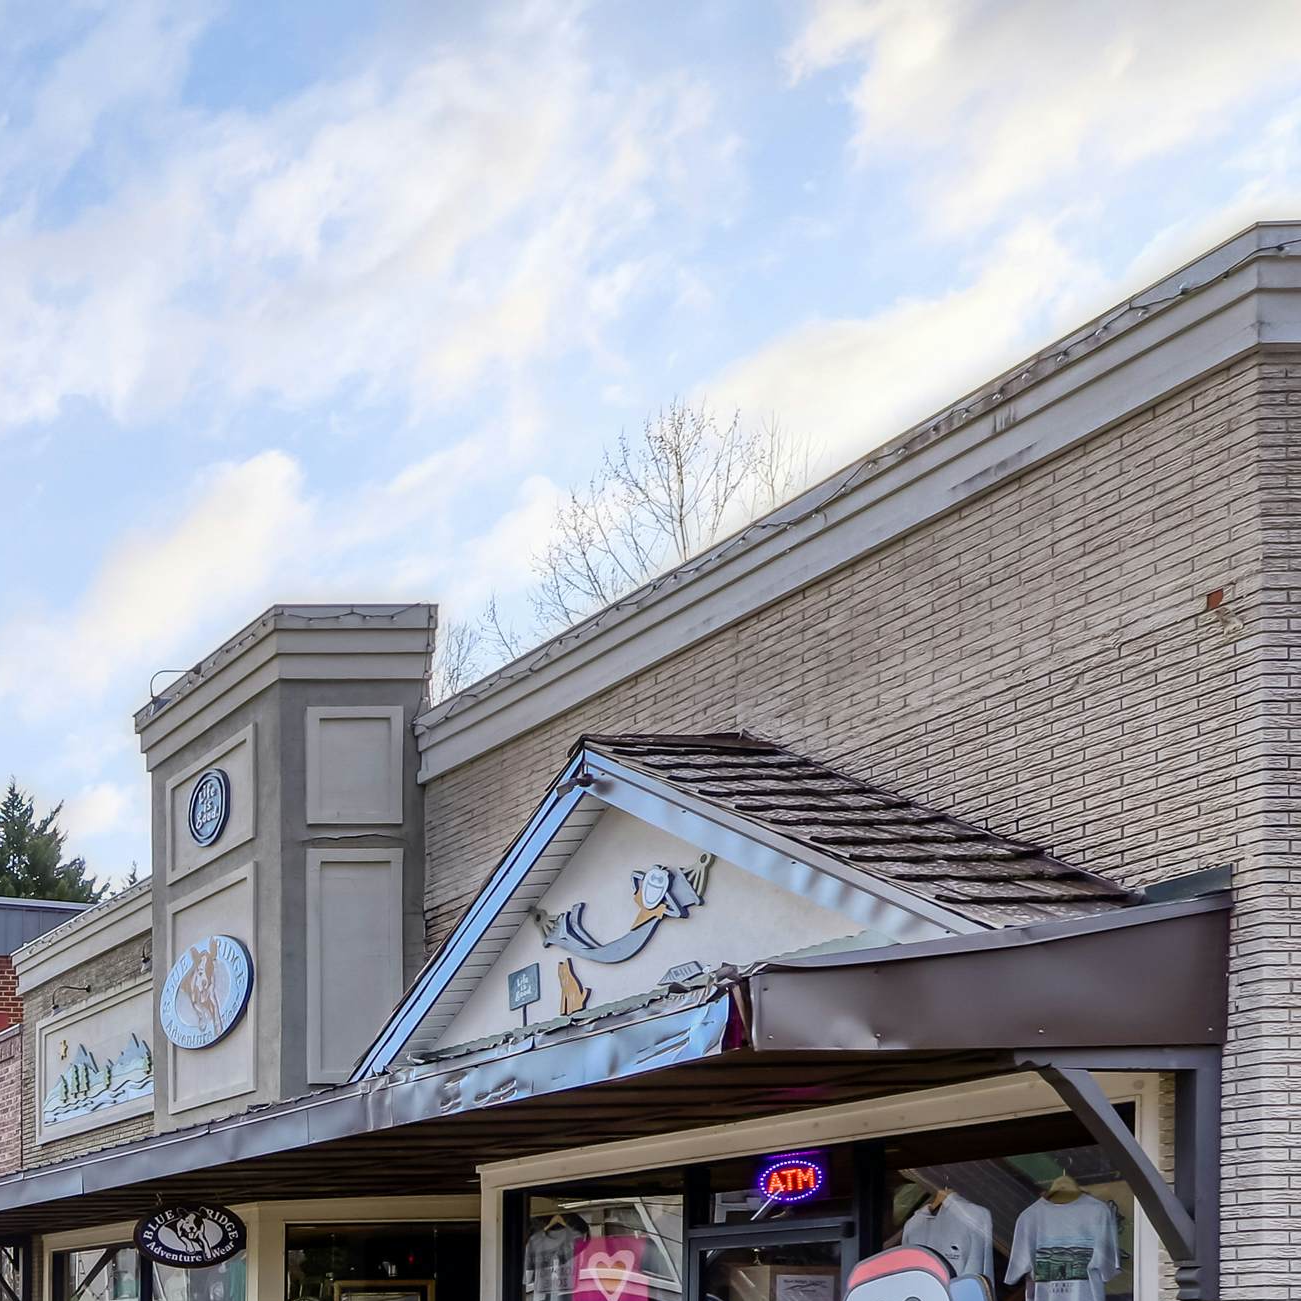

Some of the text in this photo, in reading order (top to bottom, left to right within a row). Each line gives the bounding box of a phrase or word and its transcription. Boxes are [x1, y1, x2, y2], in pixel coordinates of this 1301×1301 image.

[198, 783, 218, 805] Life
[203, 800, 213, 813] is
[165, 1020, 214, 1045] Adventure
[768, 1167, 815, 1194] ATM
[143, 1207, 239, 1240] BLUE RIDGE
[146, 1240, 235, 1262] Adventure Wear
